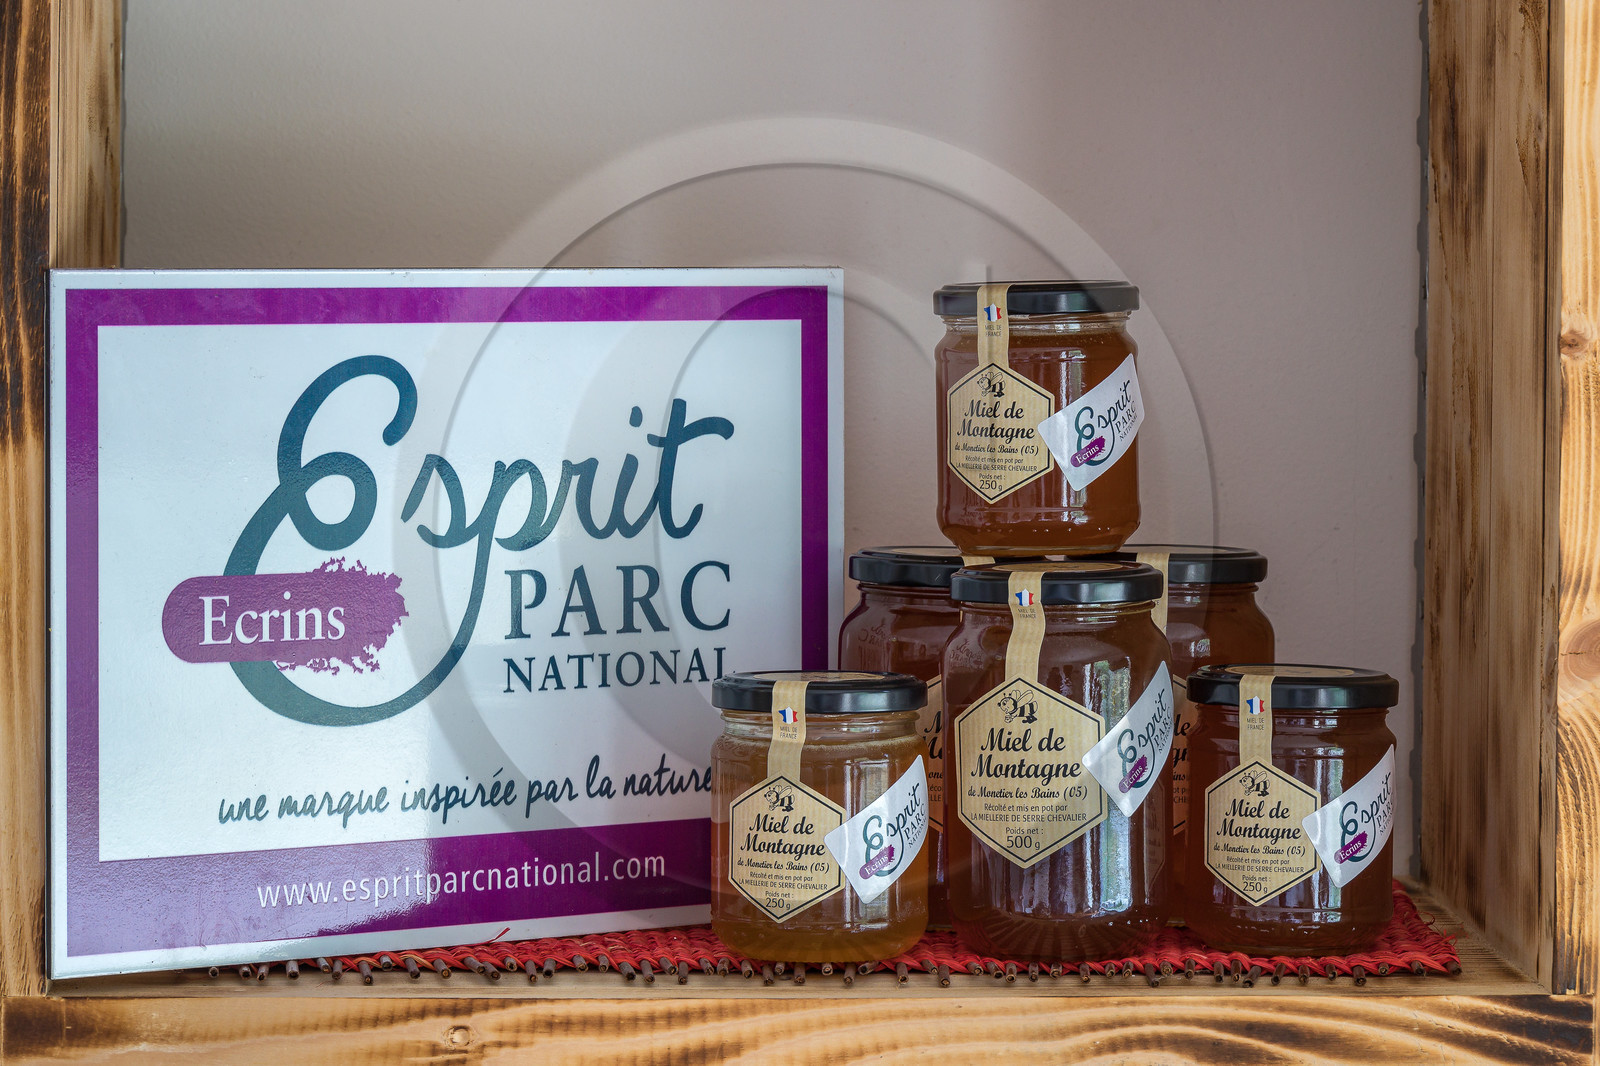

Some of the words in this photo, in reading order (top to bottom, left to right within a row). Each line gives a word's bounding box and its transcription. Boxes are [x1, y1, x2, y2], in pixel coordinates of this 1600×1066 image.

[964, 400, 1000, 419] Miel
[1004, 402, 1024, 419] de
[1115, 401, 1137, 433] PARC
[957, 421, 1034, 444] Montagne
[1075, 380, 1131, 466] Esprit
[955, 443, 960, 451] de
[961, 443, 986, 453] Monetier
[987, 445, 996, 453] les
[998, 445, 1018, 454] Bains
[1021, 445, 1039, 456] (05)
[1075, 443, 1100, 465] Ecrins
[1004, 457, 1013, 465] pot
[979, 480, 997, 490] 250
[224, 354, 735, 726] Esprit
[504, 561, 732, 639] PARC
[198, 591, 346, 648] Ecrins
[502, 648, 727, 692] NATIONAL
[1154, 707, 1172, 746] PARC
[980, 728, 1032, 752] Miel
[1038, 728, 1066, 751] de
[1117, 688, 1165, 788] Esprit
[970, 754, 1081, 786] Montagne
[1122, 764, 1143, 788] Ecrins
[218, 795, 269, 825] une
[278, 784, 389, 829] marque
[400, 766, 517, 825] inspirée
[528, 771, 577, 811] par
[584, 758, 613, 798] la
[623, 753, 712, 796] nature
[968, 786, 976, 796] de
[978, 787, 1013, 798] Monetier
[1015, 788, 1027, 798] les
[1031, 787, 1059, 798] Bains
[1063, 786, 1088, 800] (05)
[984, 803, 1006, 811] Récolté
[1041, 804, 1052, 813] pot
[1047, 814, 1086, 822] CHEVALIER
[1225, 798, 1265, 818] Miel
[1269, 801, 1290, 818] de
[1340, 772, 1391, 862] Esprit
[749, 813, 790, 834] Miel
[793, 816, 814, 834] de
[863, 782, 920, 877] Esprit
[904, 803, 926, 840] PARC
[1216, 819, 1301, 844] Montagne
[740, 833, 825, 860] Montagne
[1006, 836, 1032, 848] 500
[1035, 841, 1040, 850] g
[1214, 842, 1220, 851] de
[1221, 843, 1249, 854] Monetier
[1250, 844, 1260, 854] les
[1262, 845, 1284, 855] Bains
[1286, 846, 1305, 856] (05)
[1339, 839, 1362, 861] Ecrins
[737, 857, 744, 866] de
[745, 858, 772, 870] Monetier
[774, 860, 784, 870] les
[786, 861, 807, 871] Bains
[810, 862, 830, 874] (05)
[864, 853, 889, 876] Ecrins
[1222, 863, 1245, 872] MIELLERIE
[1270, 858, 1279, 866] pot
[258, 855, 666, 907] www.espritparcnational.com
[746, 879, 769, 887] MIELLERIE
[793, 875, 802, 883] pot
[1242, 882, 1261, 892] 250
[766, 898, 784, 908] 250
